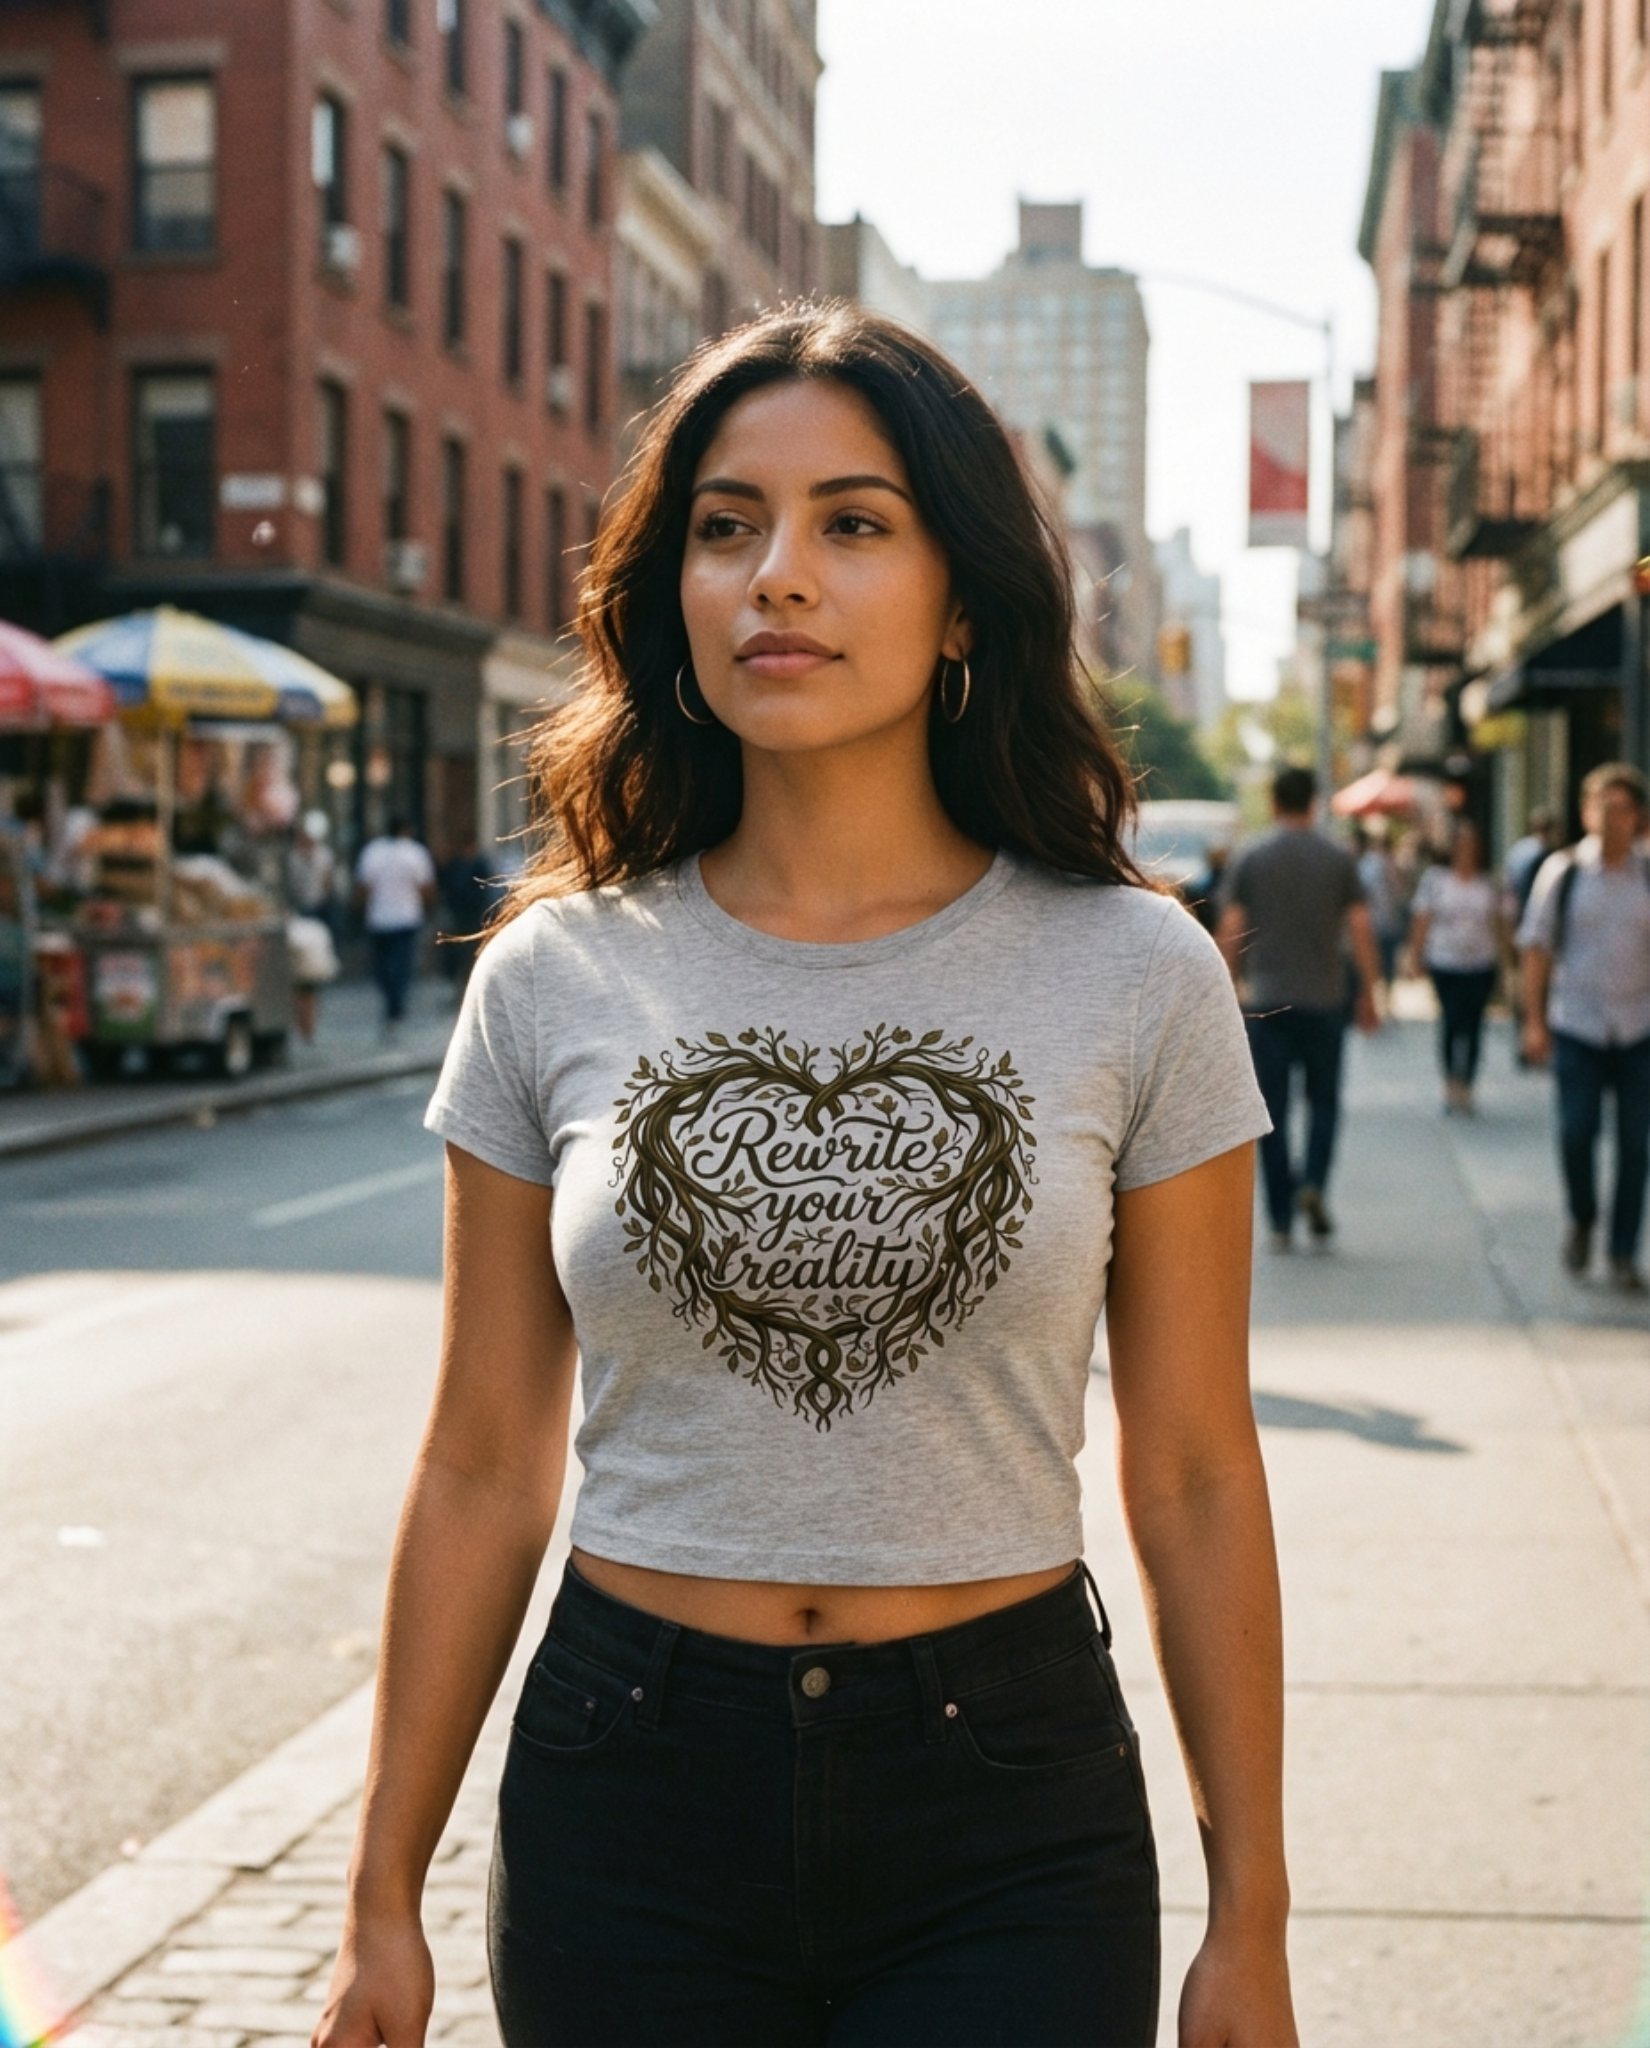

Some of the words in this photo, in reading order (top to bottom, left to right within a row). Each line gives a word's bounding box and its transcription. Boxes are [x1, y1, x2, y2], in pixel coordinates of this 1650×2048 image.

[691, 1106, 935, 1188] Rewrite
[752, 1185, 902, 1252] your
[704, 1228, 931, 1325] reality
